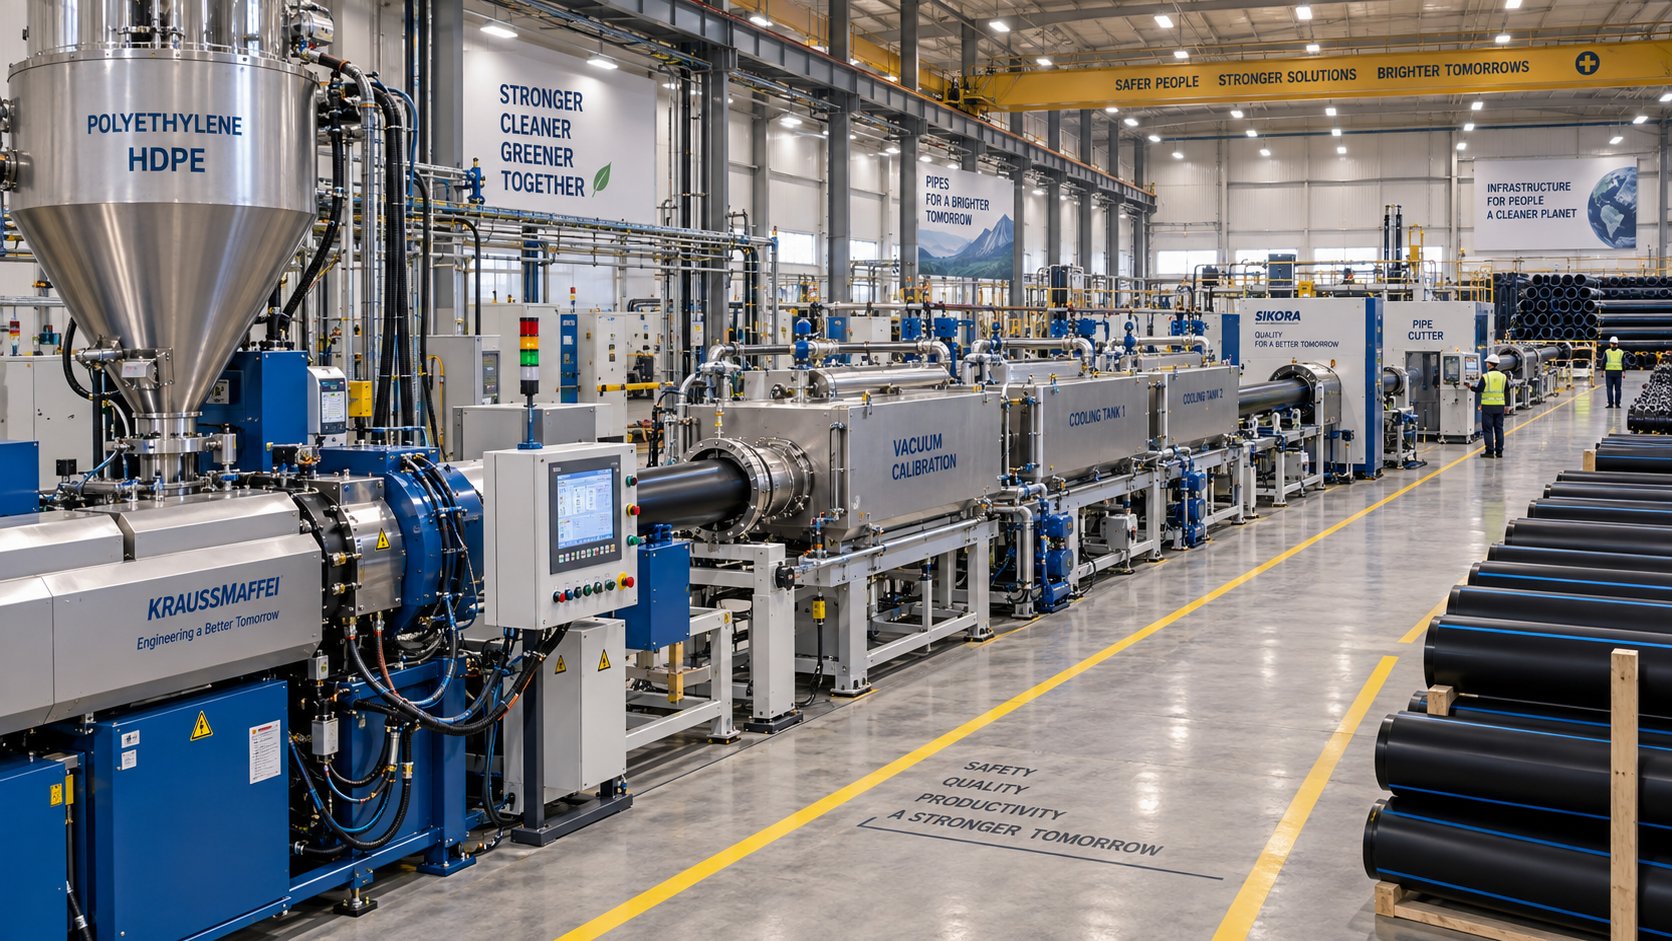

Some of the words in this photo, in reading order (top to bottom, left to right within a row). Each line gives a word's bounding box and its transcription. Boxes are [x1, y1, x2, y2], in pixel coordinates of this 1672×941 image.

[1115, 78, 1151, 91] SAFER
[1156, 75, 1200, 89] PEOPLE
[1218, 72, 1283, 86] STRONGER
[1287, 68, 1357, 83] SOLUTIONS
[1377, 64, 1440, 79] BRIGHTER
[1445, 60, 1530, 77] TOMORROWS
[500, 83, 583, 112] STRONGER
[88, 113, 242, 136] POLYETHYLENE
[500, 113, 571, 139] CLEANER
[129, 147, 205, 172] HDPE
[501, 142, 574, 168] GREENER
[501, 170, 585, 197] TOGETHER
[926, 175, 950, 190] PIPES
[1487, 182, 1571, 193] INFRASTRUCTURE
[926, 193, 942, 206] FOR
[944, 195, 950, 207] A
[951, 196, 990, 211] BRIGHTER
[1487, 196, 1506, 206] FOR
[1508, 195, 1544, 206] PEOPLE
[926, 210, 973, 226] TOMORROW
[1487, 210, 1493, 219] A
[1495, 209, 1538, 219] CLEANER
[1541, 208, 1577, 218] PLANET
[1255, 310, 1301, 321] SIKORA
[1412, 319, 1433, 329] PIPE
[1254, 331, 1283, 339] QUALITY
[1255, 340, 1268, 348] FOR
[1268, 340, 1274, 348] A
[1275, 340, 1299, 348] BETTER
[1300, 340, 1339, 348] TOMORROW
[1408, 331, 1444, 341] CUTTER
[1183, 391, 1206, 405] COOLING
[1206, 389, 1219, 401] TANK
[1219, 388, 1224, 399] 2
[1069, 409, 1101, 427] COOLING
[1102, 406, 1120, 421] TANK
[1122, 405, 1126, 418] 1
[893, 433, 942, 457] VACUUM
[892, 453, 957, 480] CALIBRATION
[147, 576, 280, 621] KRAUSSMAFFEI
[137, 628, 194, 650] Engineering
[196, 627, 202, 637] a
[205, 619, 234, 635] Better
[236, 610, 280, 628] Tomorrow
[963, 761, 1038, 778] SAFETY
[942, 776, 1031, 795] QUALITY
[915, 793, 1067, 821] PRODUCTIVITY
[887, 809, 906, 820] A
[908, 811, 1022, 836] STRONGER
[1030, 828, 1164, 857] TOMORROW
